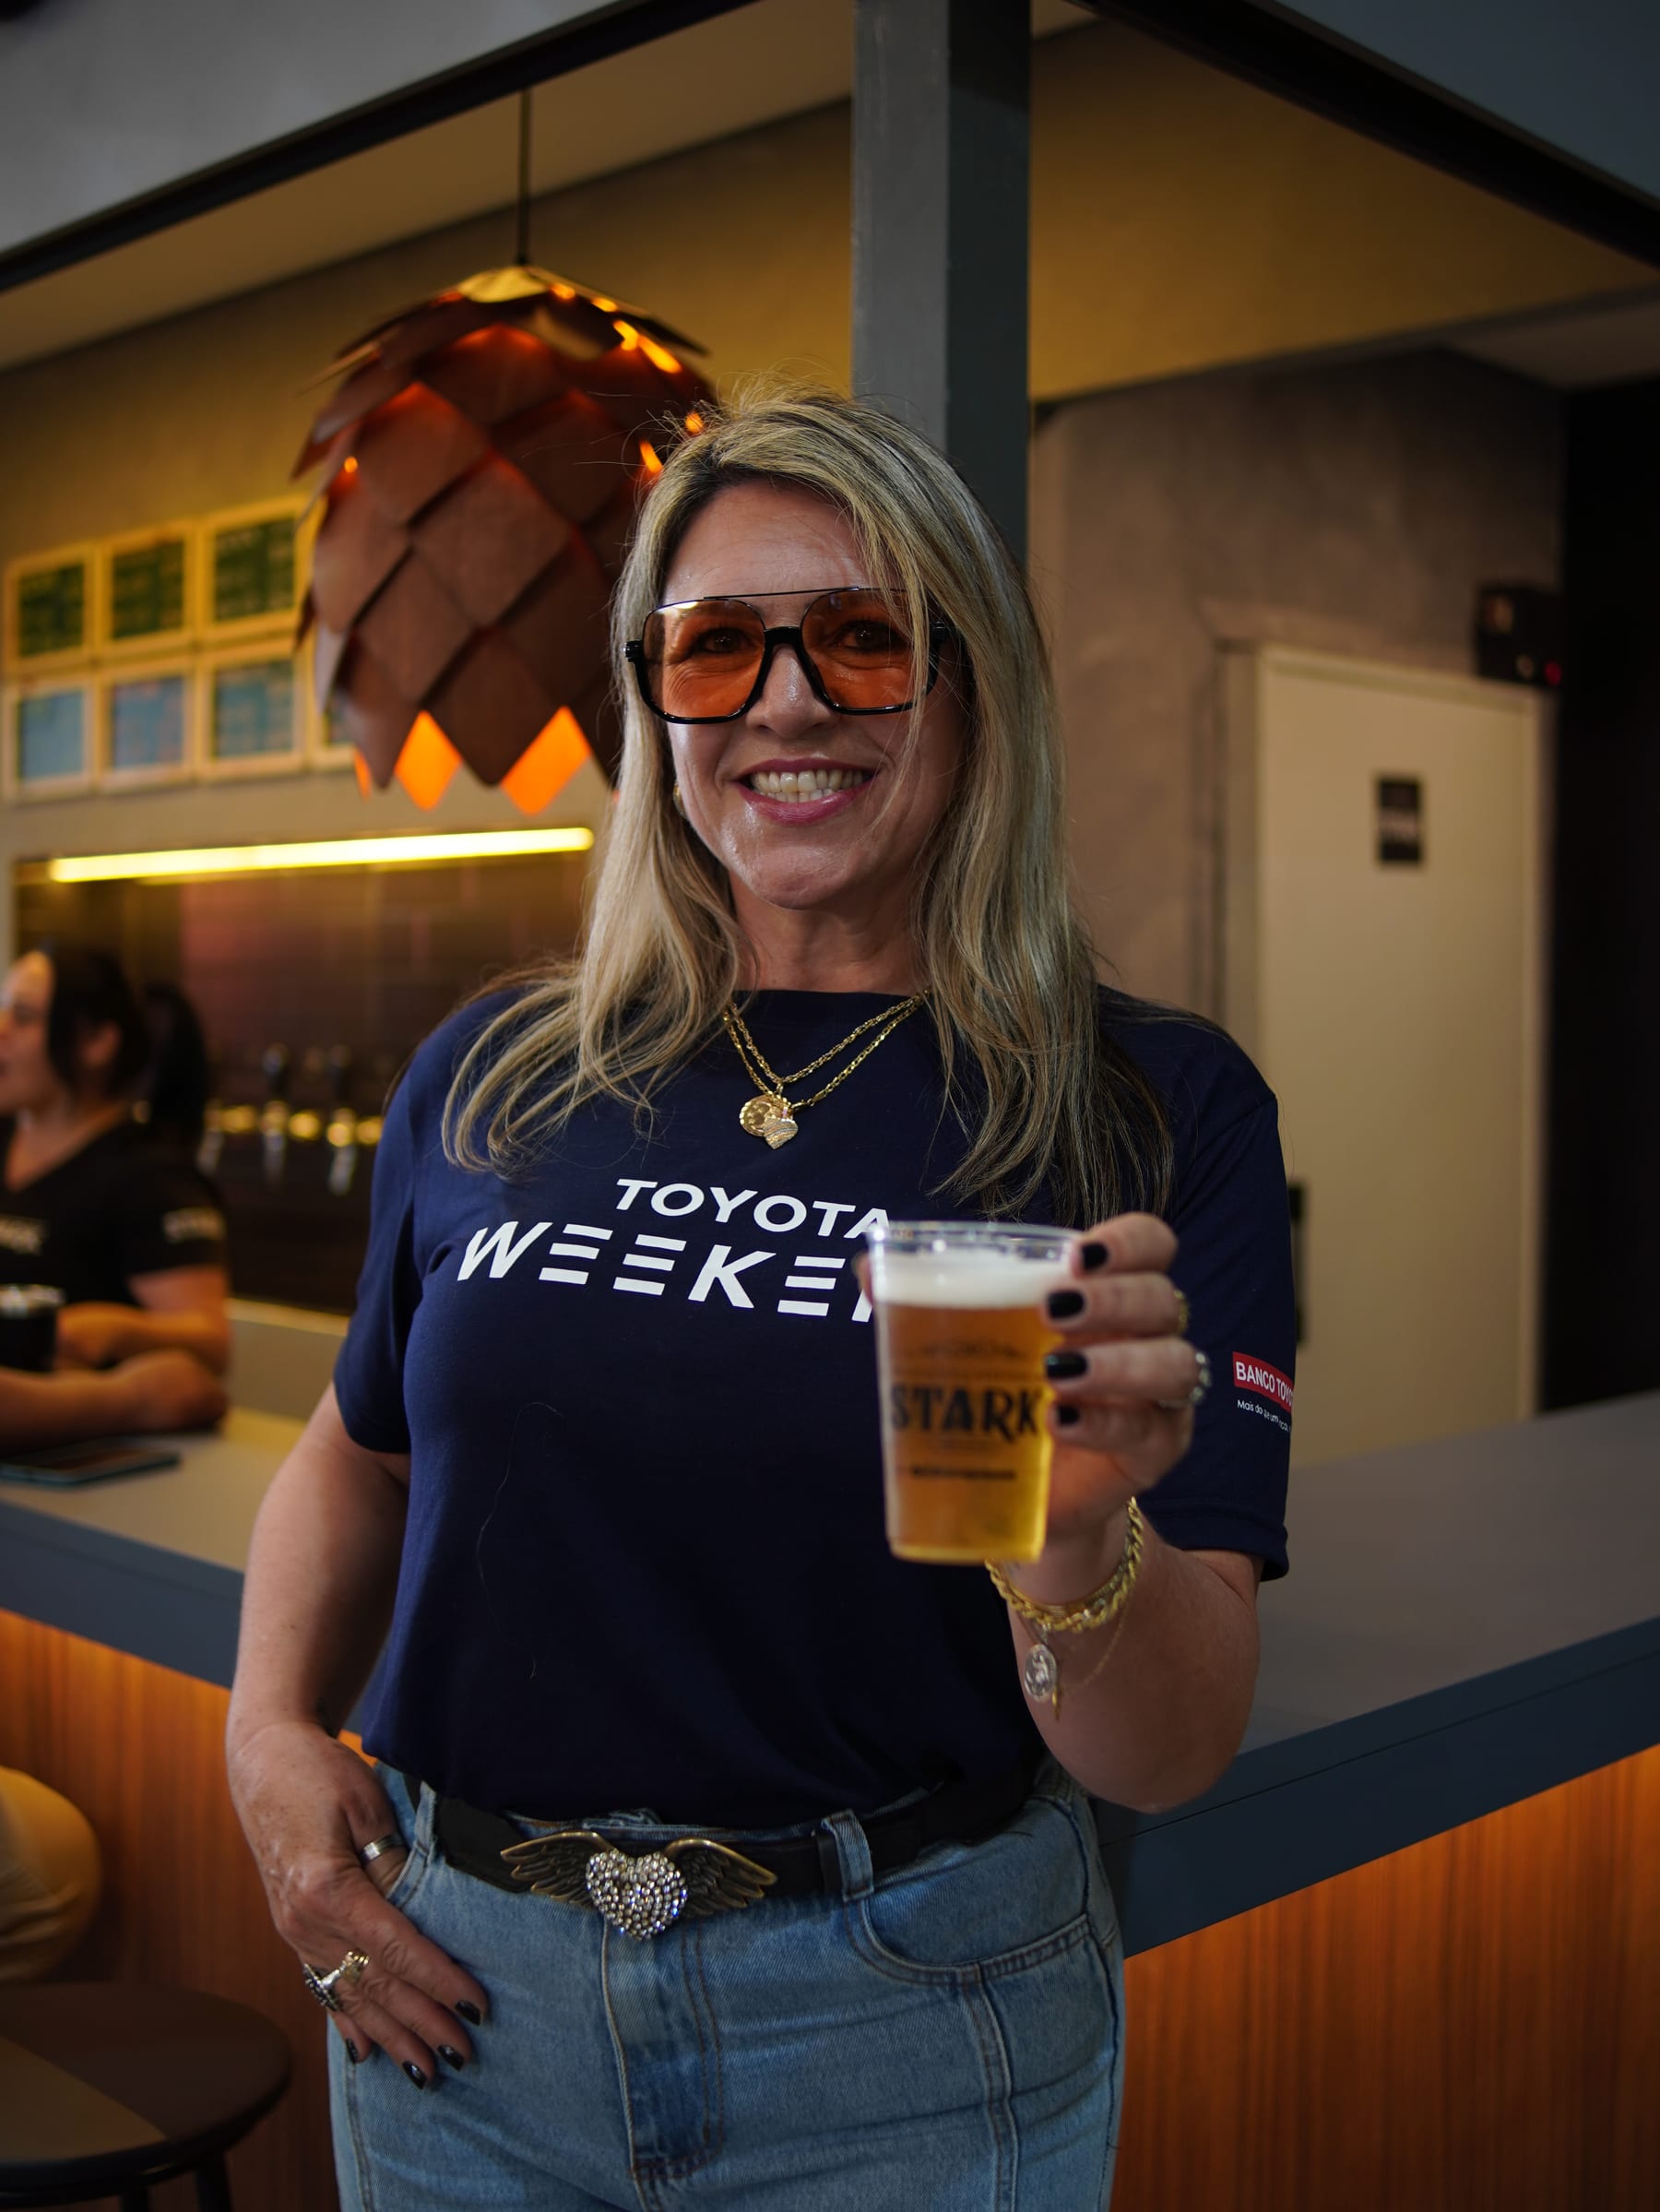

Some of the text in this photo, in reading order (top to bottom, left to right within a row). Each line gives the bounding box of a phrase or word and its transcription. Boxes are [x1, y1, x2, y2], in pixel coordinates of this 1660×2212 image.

[616, 1179, 890, 1239] TOYOTA
[1236, 1361, 1275, 1393] BANCO
[892, 1382, 1041, 1444] STARK
[1237, 1399, 1254, 1412] Mais
